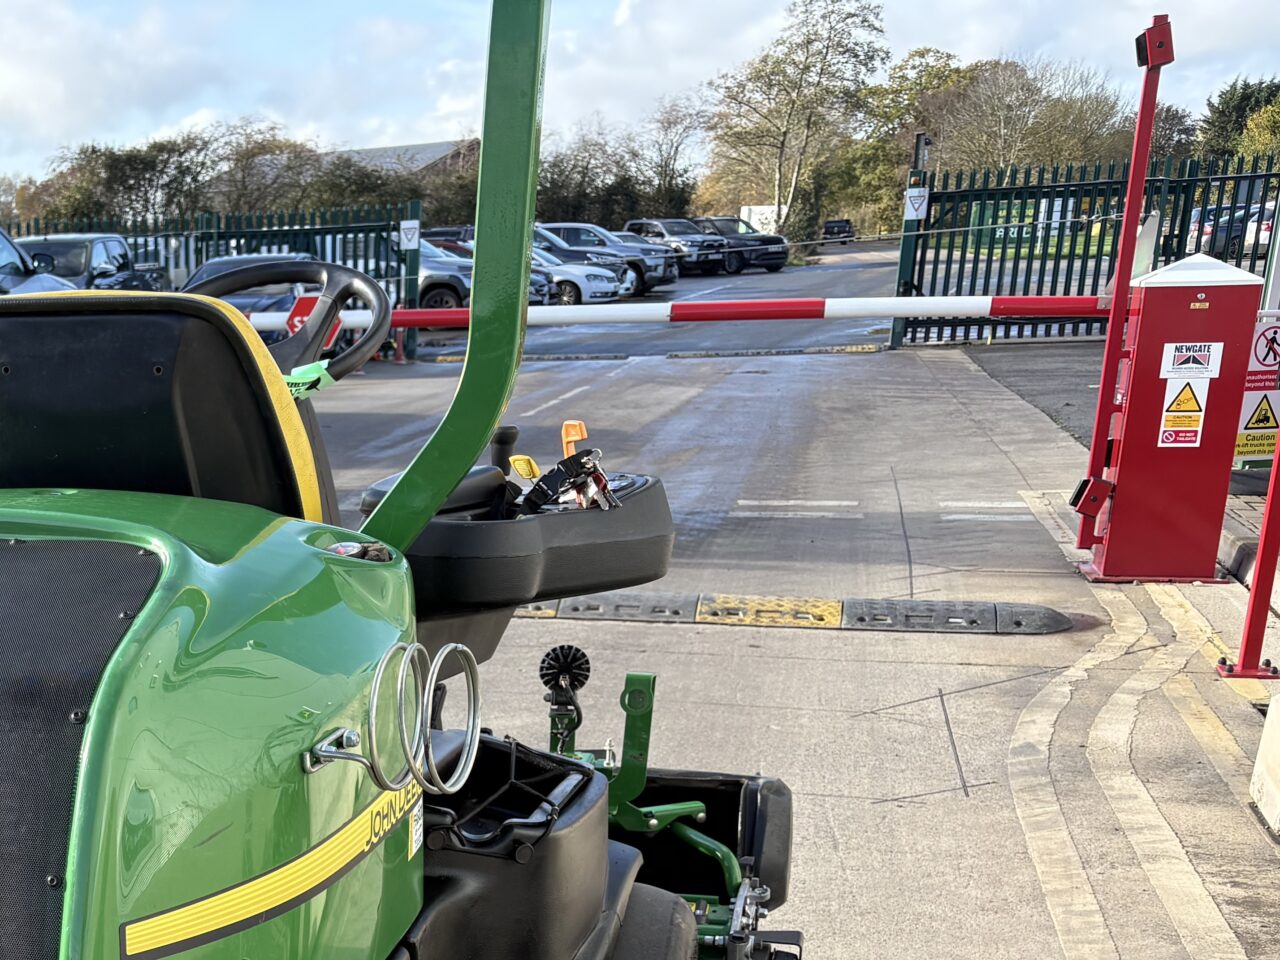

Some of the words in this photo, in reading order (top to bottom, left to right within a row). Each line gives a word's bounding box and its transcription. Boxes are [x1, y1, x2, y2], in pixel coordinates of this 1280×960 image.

[1175, 344, 1212, 354] NEWGATE
[1245, 434, 1276, 442] Caution
[365, 792, 398, 849] JOHN
